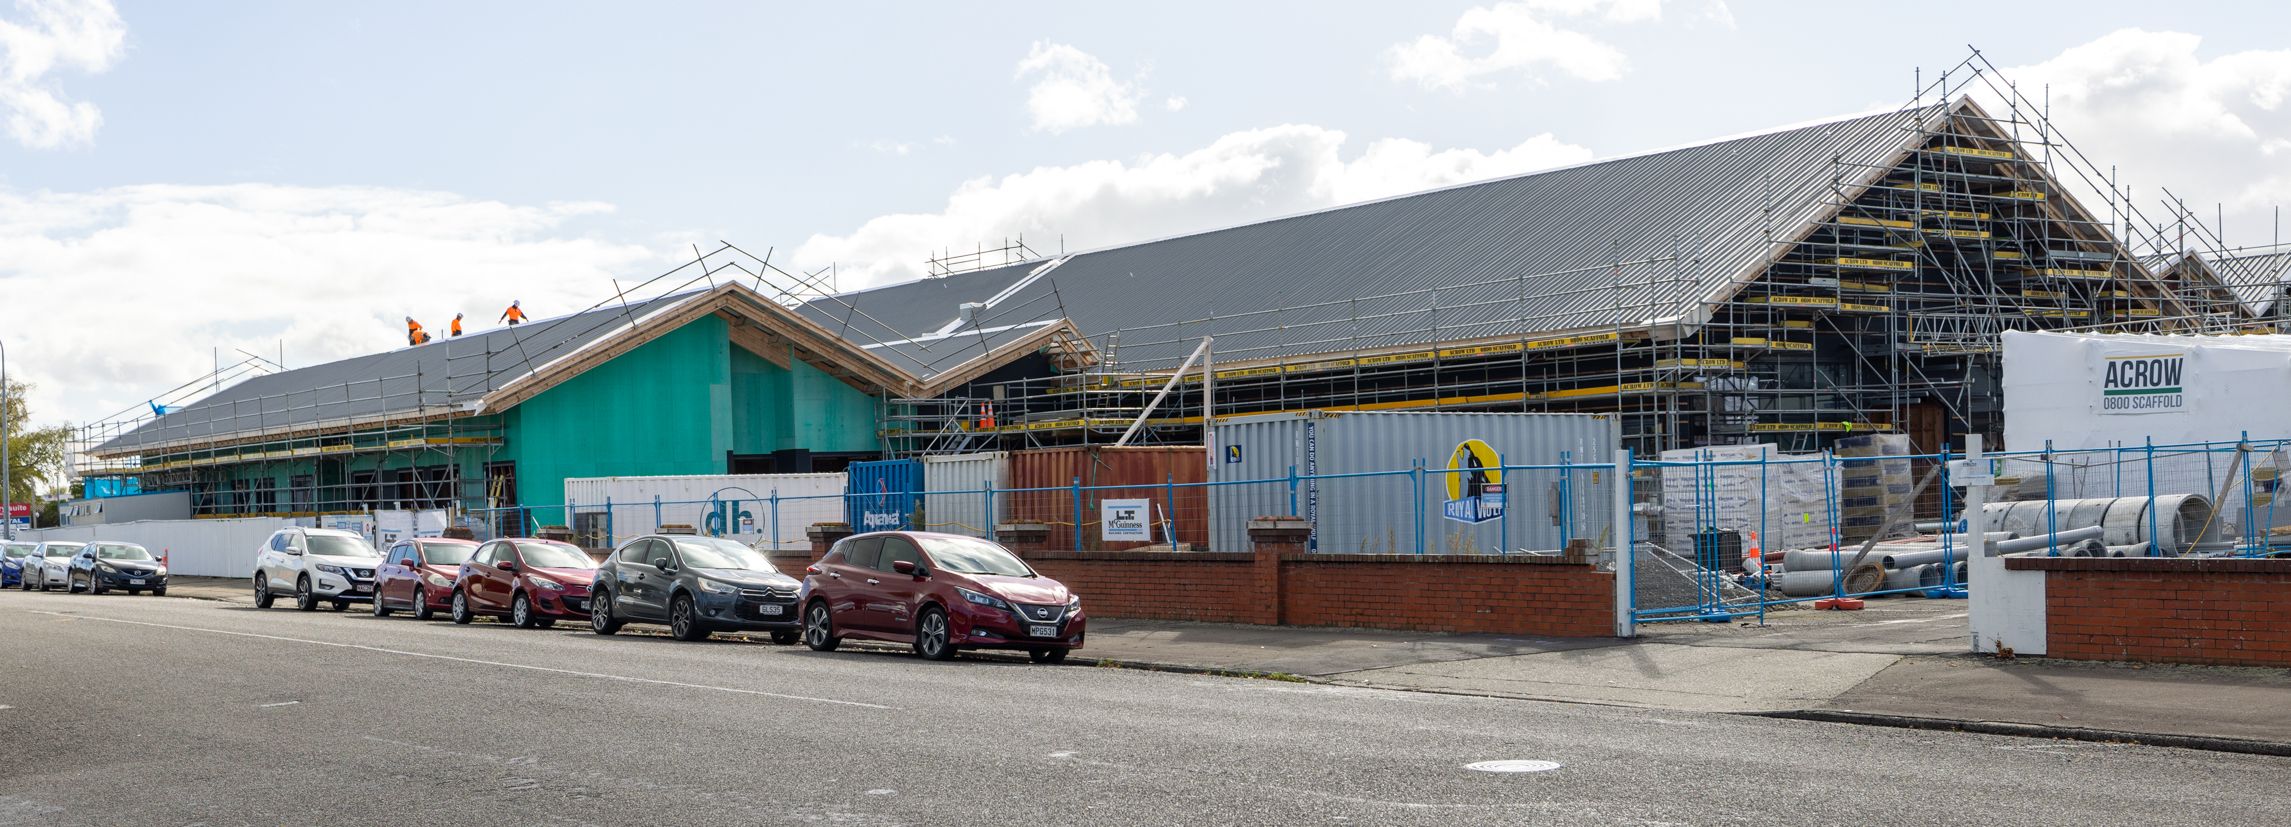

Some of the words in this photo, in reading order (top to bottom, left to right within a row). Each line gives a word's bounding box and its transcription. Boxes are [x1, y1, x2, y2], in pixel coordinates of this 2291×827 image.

[2104, 358, 2183, 388] ACROW
[2103, 396, 2130, 410] 0800
[2132, 394, 2182, 409] SCAFFOLD
[1309, 452, 1315, 461] DO
[1447, 500, 1474, 519] ROYAL
[1108, 519, 1143, 529] McGuinness
